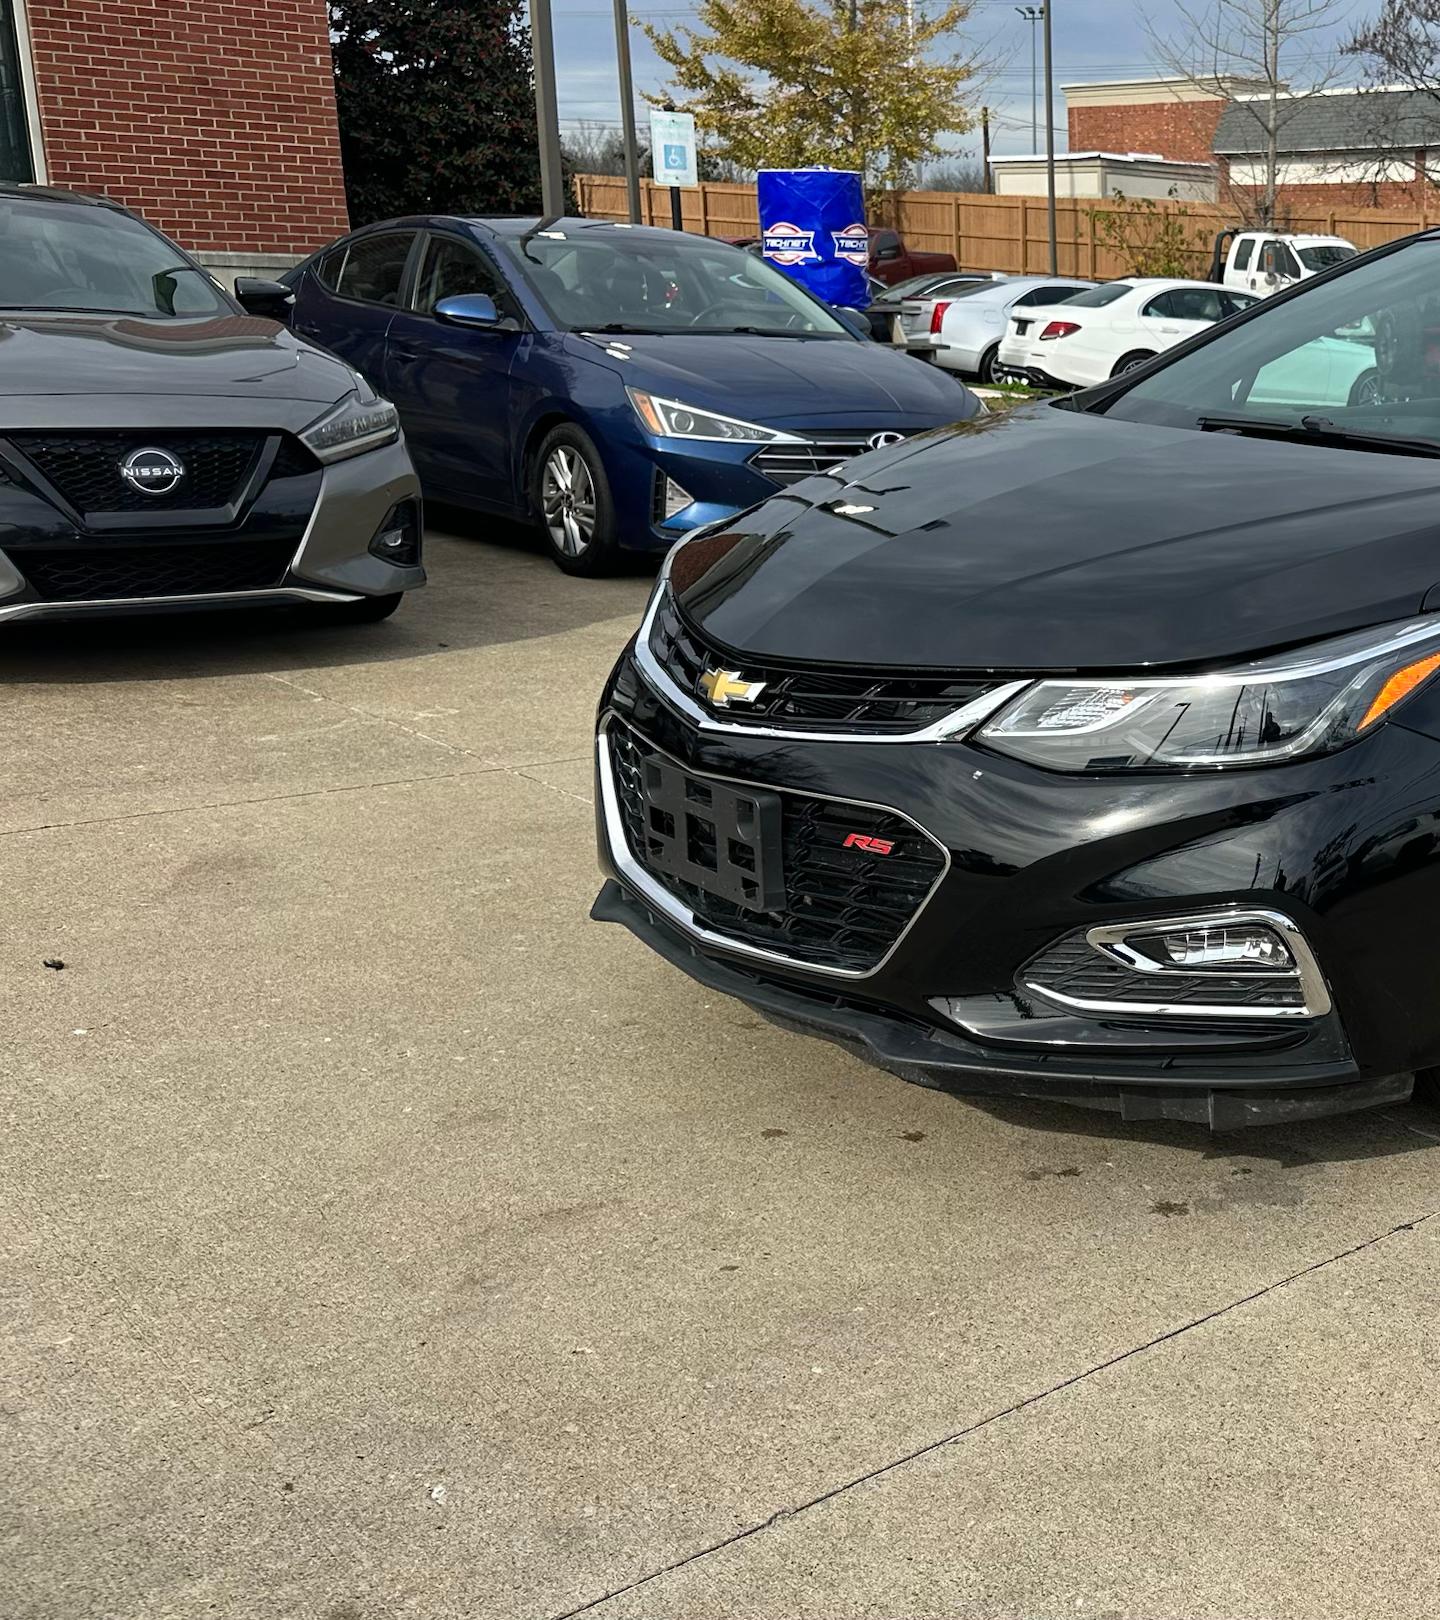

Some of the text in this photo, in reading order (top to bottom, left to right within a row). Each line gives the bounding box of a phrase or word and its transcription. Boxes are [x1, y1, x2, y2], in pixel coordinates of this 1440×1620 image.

[839, 239, 868, 249] TECHN
[123, 467, 183, 476] NISSAN
[842, 833, 896, 855] RS
